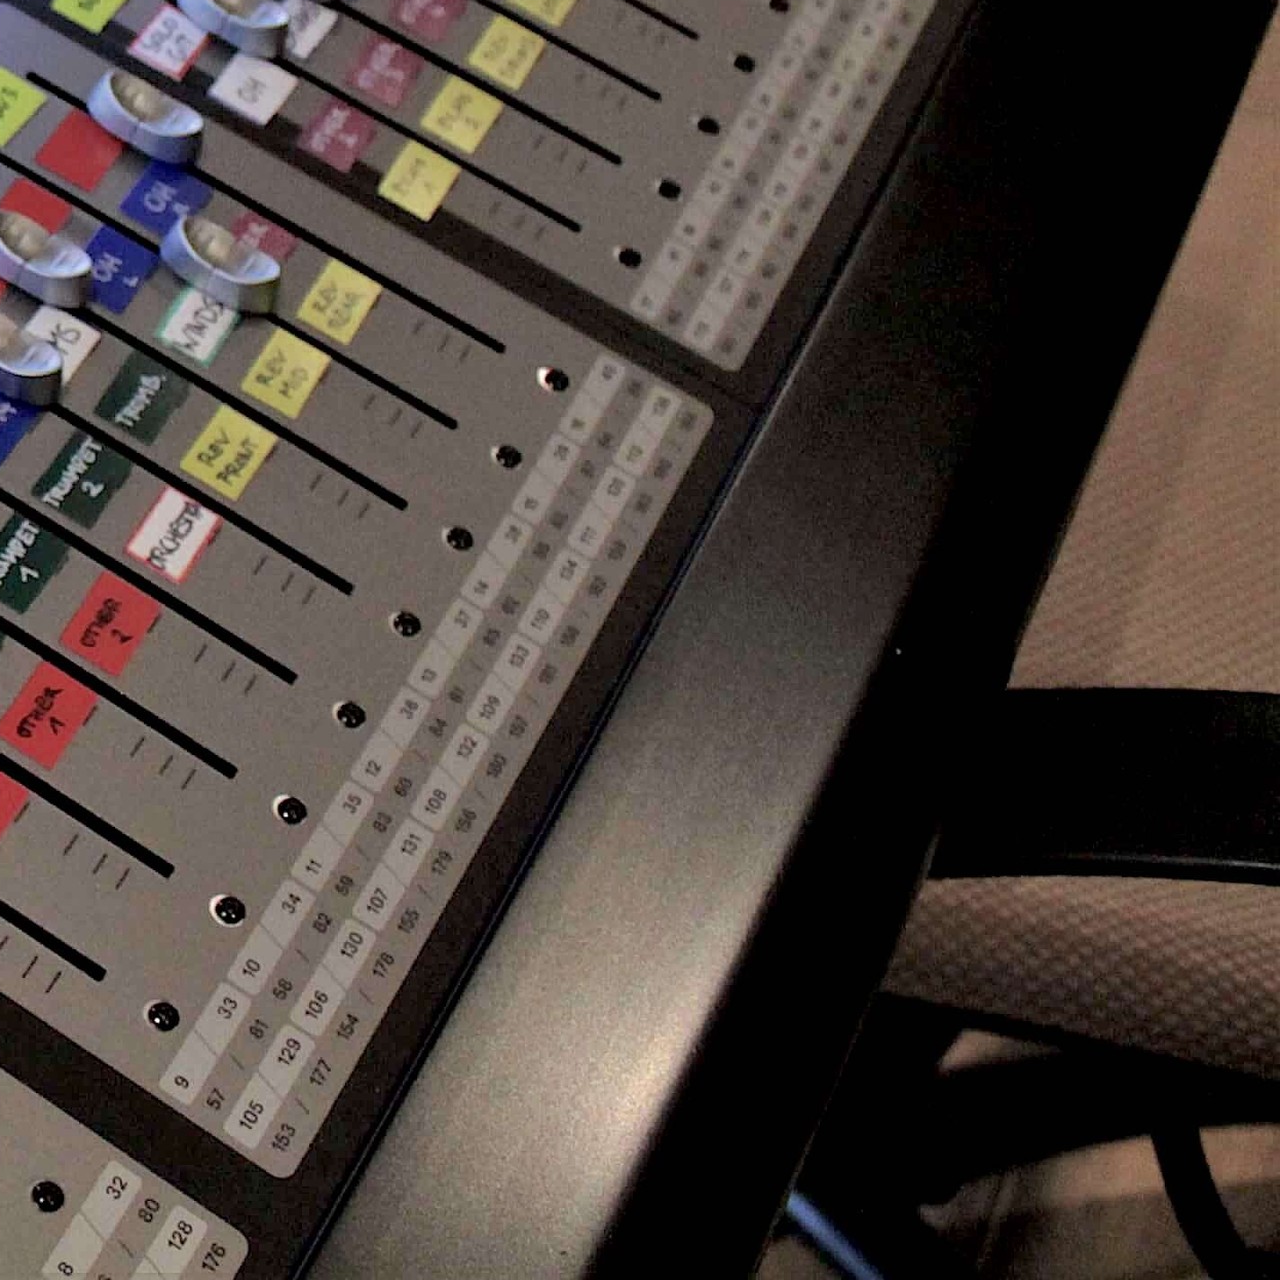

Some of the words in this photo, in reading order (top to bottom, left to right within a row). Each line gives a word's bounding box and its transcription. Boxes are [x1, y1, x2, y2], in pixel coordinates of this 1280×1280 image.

[81, 479, 105, 500] 2
[306, 860, 321, 873] 11
[282, 894, 301, 913] 34
[367, 888, 387, 913] 107
[341, 932, 363, 958] 130
[243, 959, 260, 977] 10
[218, 997, 237, 1019] 33
[305, 991, 328, 1018] 106
[250, 1019, 268, 1039] 81
[337, 1014, 359, 1039] 154
[278, 1039, 300, 1064] 129
[175, 1076, 189, 1088] 9
[310, 1057, 331, 1085] 177
[207, 1088, 224, 1110] 57
[240, 1100, 263, 1129] 105
[272, 1124, 295, 1151] 153
[106, 1176, 127, 1199] 32
[139, 1199, 160, 1223] 80
[168, 1221, 192, 1249] 128
[58, 1262, 73, 1276] 8
[202, 1243, 225, 1271] 176
